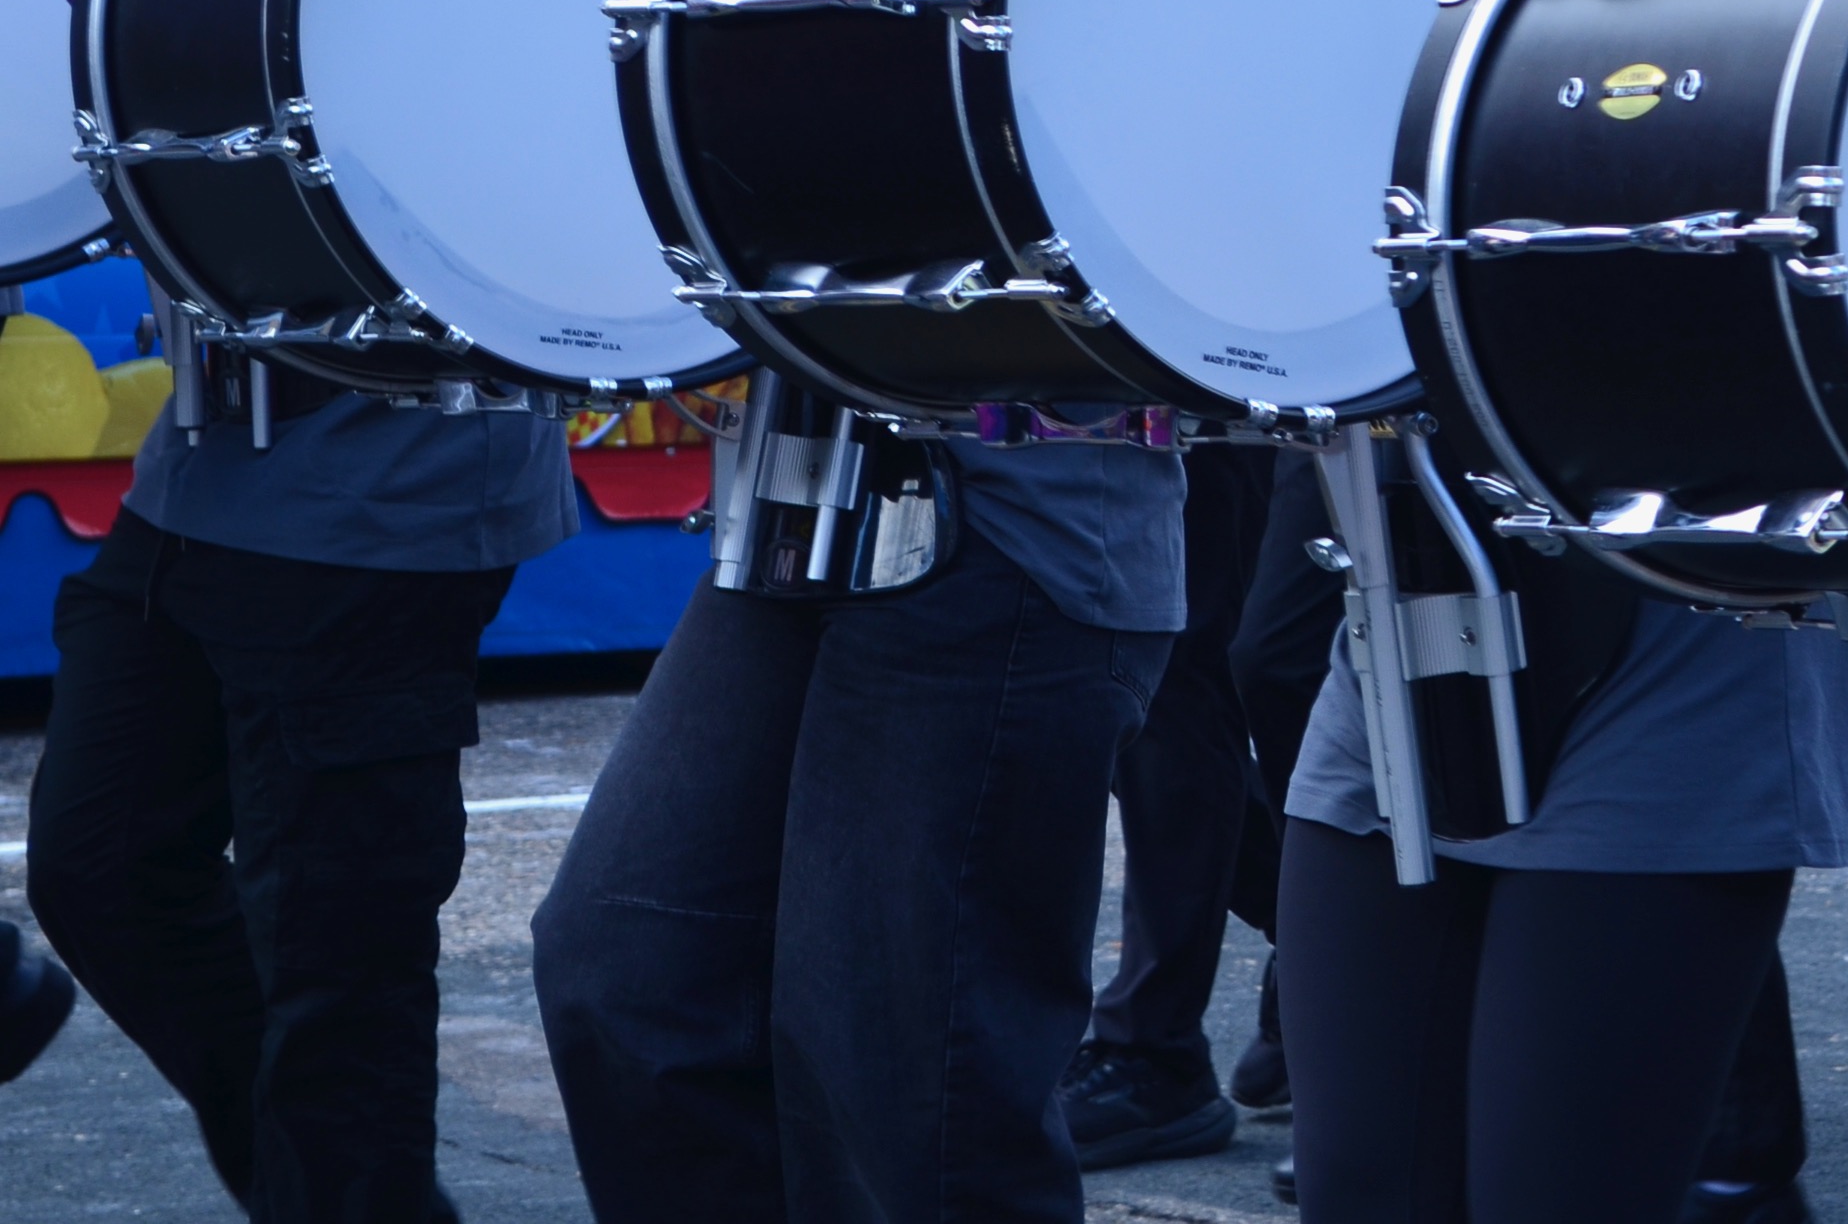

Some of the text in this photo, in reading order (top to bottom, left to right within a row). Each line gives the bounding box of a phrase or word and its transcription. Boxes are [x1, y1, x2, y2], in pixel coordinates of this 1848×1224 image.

[562, 328, 604, 340] HEAD ONLY
[540, 335, 560, 345] MADE
[562, 337, 574, 347] BY
[1226, 346, 1248, 358] HEAD
[1203, 353, 1226, 366] MADE
